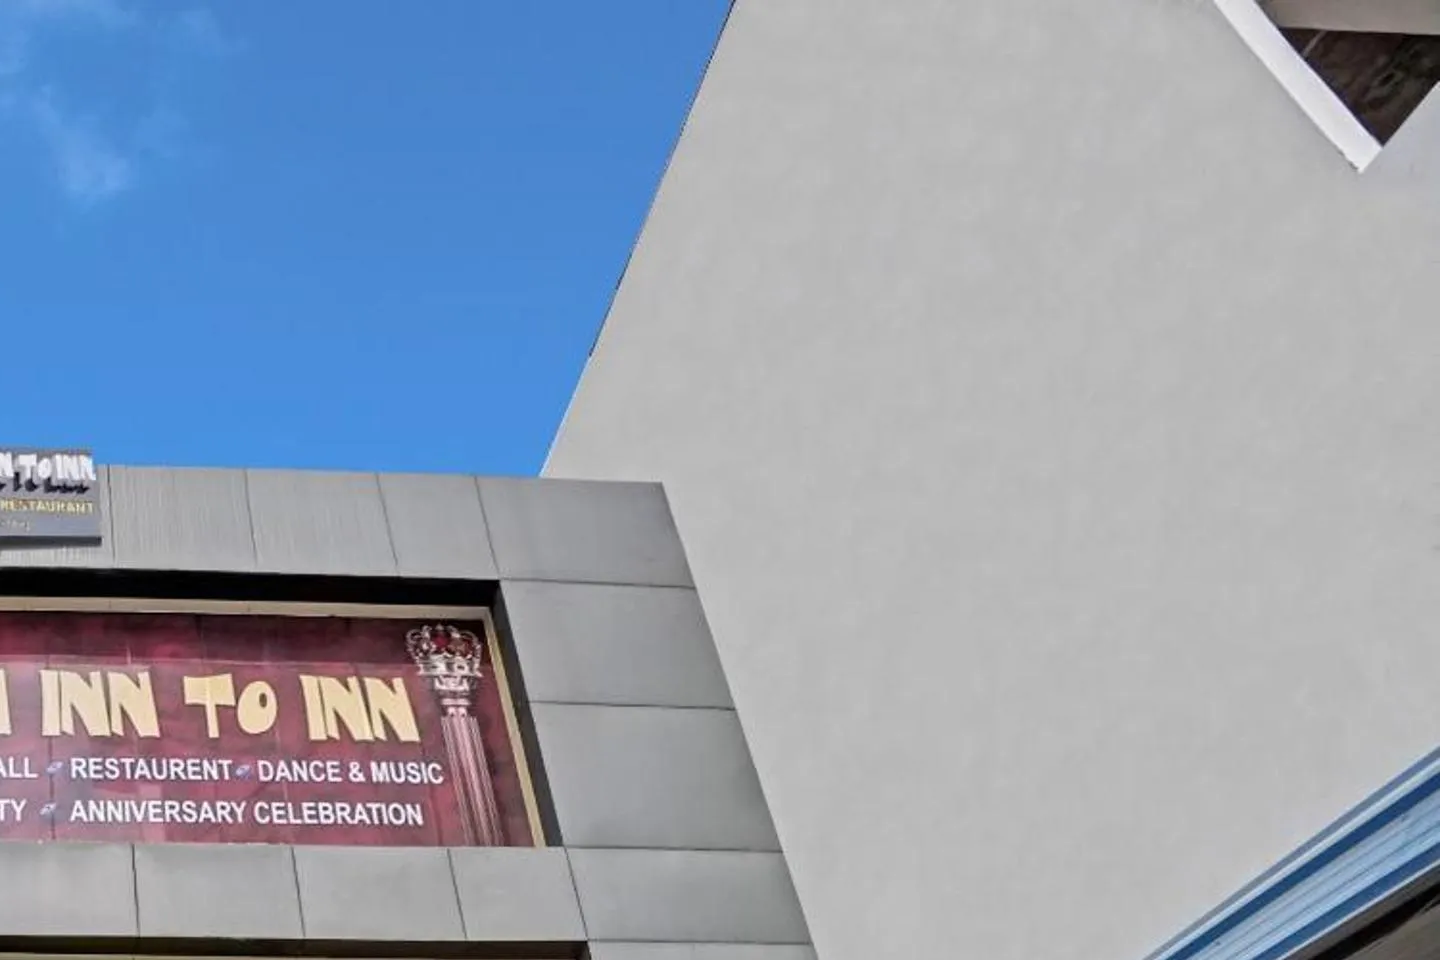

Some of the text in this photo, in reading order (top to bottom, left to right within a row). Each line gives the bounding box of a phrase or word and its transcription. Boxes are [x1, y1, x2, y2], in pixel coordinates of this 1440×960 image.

[54, 453, 97, 481] INN
[0, 500, 95, 515] RESTAURANT
[39, 668, 160, 737] INN
[300, 674, 420, 742] INN
[70, 757, 233, 781] RESTAURENT
[258, 760, 343, 783] DANCE
[348, 761, 366, 783] &
[370, 761, 444, 785] MUSIC
[69, 800, 247, 823] ANNIVERSARY
[253, 801, 424, 826] CELEBRATION
